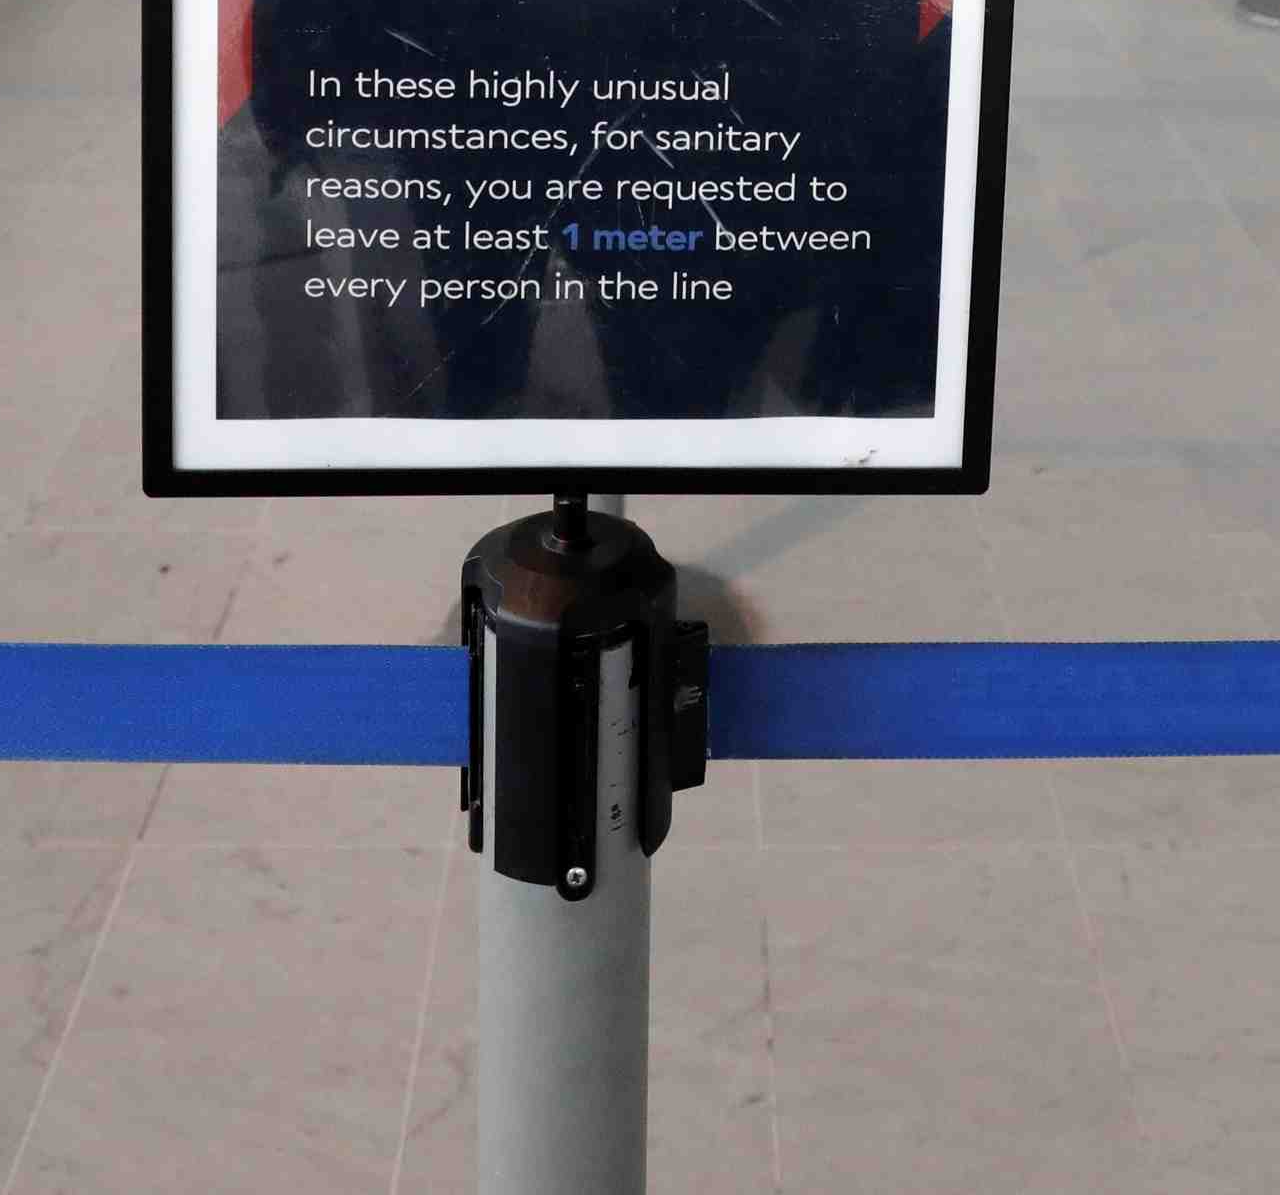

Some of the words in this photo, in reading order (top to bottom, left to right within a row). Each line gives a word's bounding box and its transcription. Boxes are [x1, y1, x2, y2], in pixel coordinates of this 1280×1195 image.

[310, 70, 340, 96] In
[355, 69, 455, 98] these
[470, 70, 579, 108] highly
[594, 72, 728, 100] unusual
[306, 121, 578, 157] circumstances,
[592, 122, 643, 149] for
[655, 125, 801, 161] sanitary
[307, 175, 452, 206] reasons,
[466, 178, 532, 209] you
[546, 180, 602, 199] are
[617, 173, 795, 209] requested
[810, 177, 847, 201] to
[308, 220, 399, 248] leave
[413, 225, 450, 249] at
[465, 221, 548, 249] least
[563, 223, 578, 249] 1
[594, 226, 703, 250] meter
[715, 221, 871, 250] between
[305, 275, 407, 307] every
[421, 280, 539, 307] person
[556, 274, 583, 299] in
[599, 272, 658, 299] the
[673, 272, 732, 299] line
